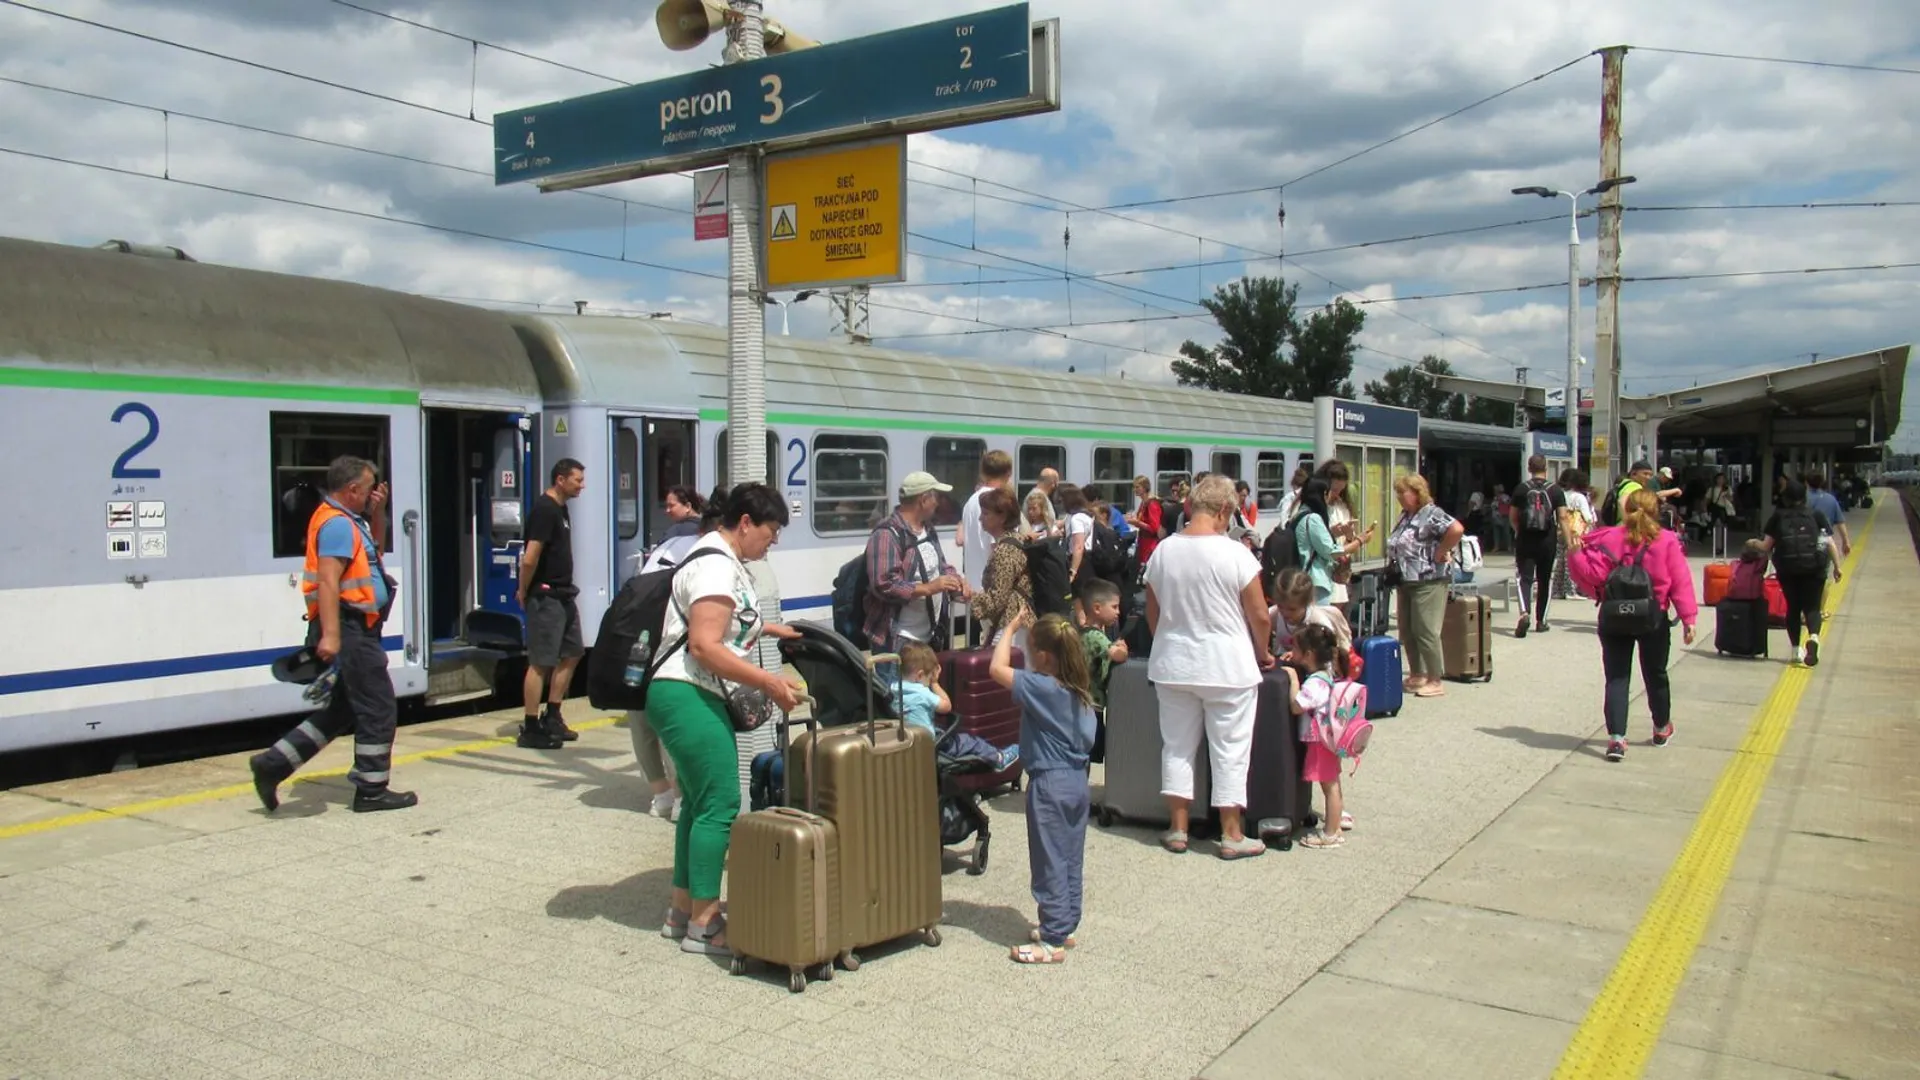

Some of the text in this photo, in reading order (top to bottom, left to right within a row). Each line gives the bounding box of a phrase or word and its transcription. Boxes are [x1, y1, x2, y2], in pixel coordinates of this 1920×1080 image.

[955, 25, 975, 37] tor
[960, 46, 973, 69] 2
[935, 80, 962, 96] track
[660, 74, 784, 130] peron 3
[523, 115, 536, 125] tor
[525, 131, 535, 149] 4
[662, 129, 698, 145] platform
[836, 174, 855, 189] SIEĆ
[814, 188, 879, 208] TRAKCYJNA POD
[822, 207, 864, 225] NAPIĘCIEM
[809, 222, 883, 242] DOTKNIĘCIE GROZI
[110, 402, 161, 479] 2
[787, 438, 807, 486] 2
[504, 472, 513, 485] 22
